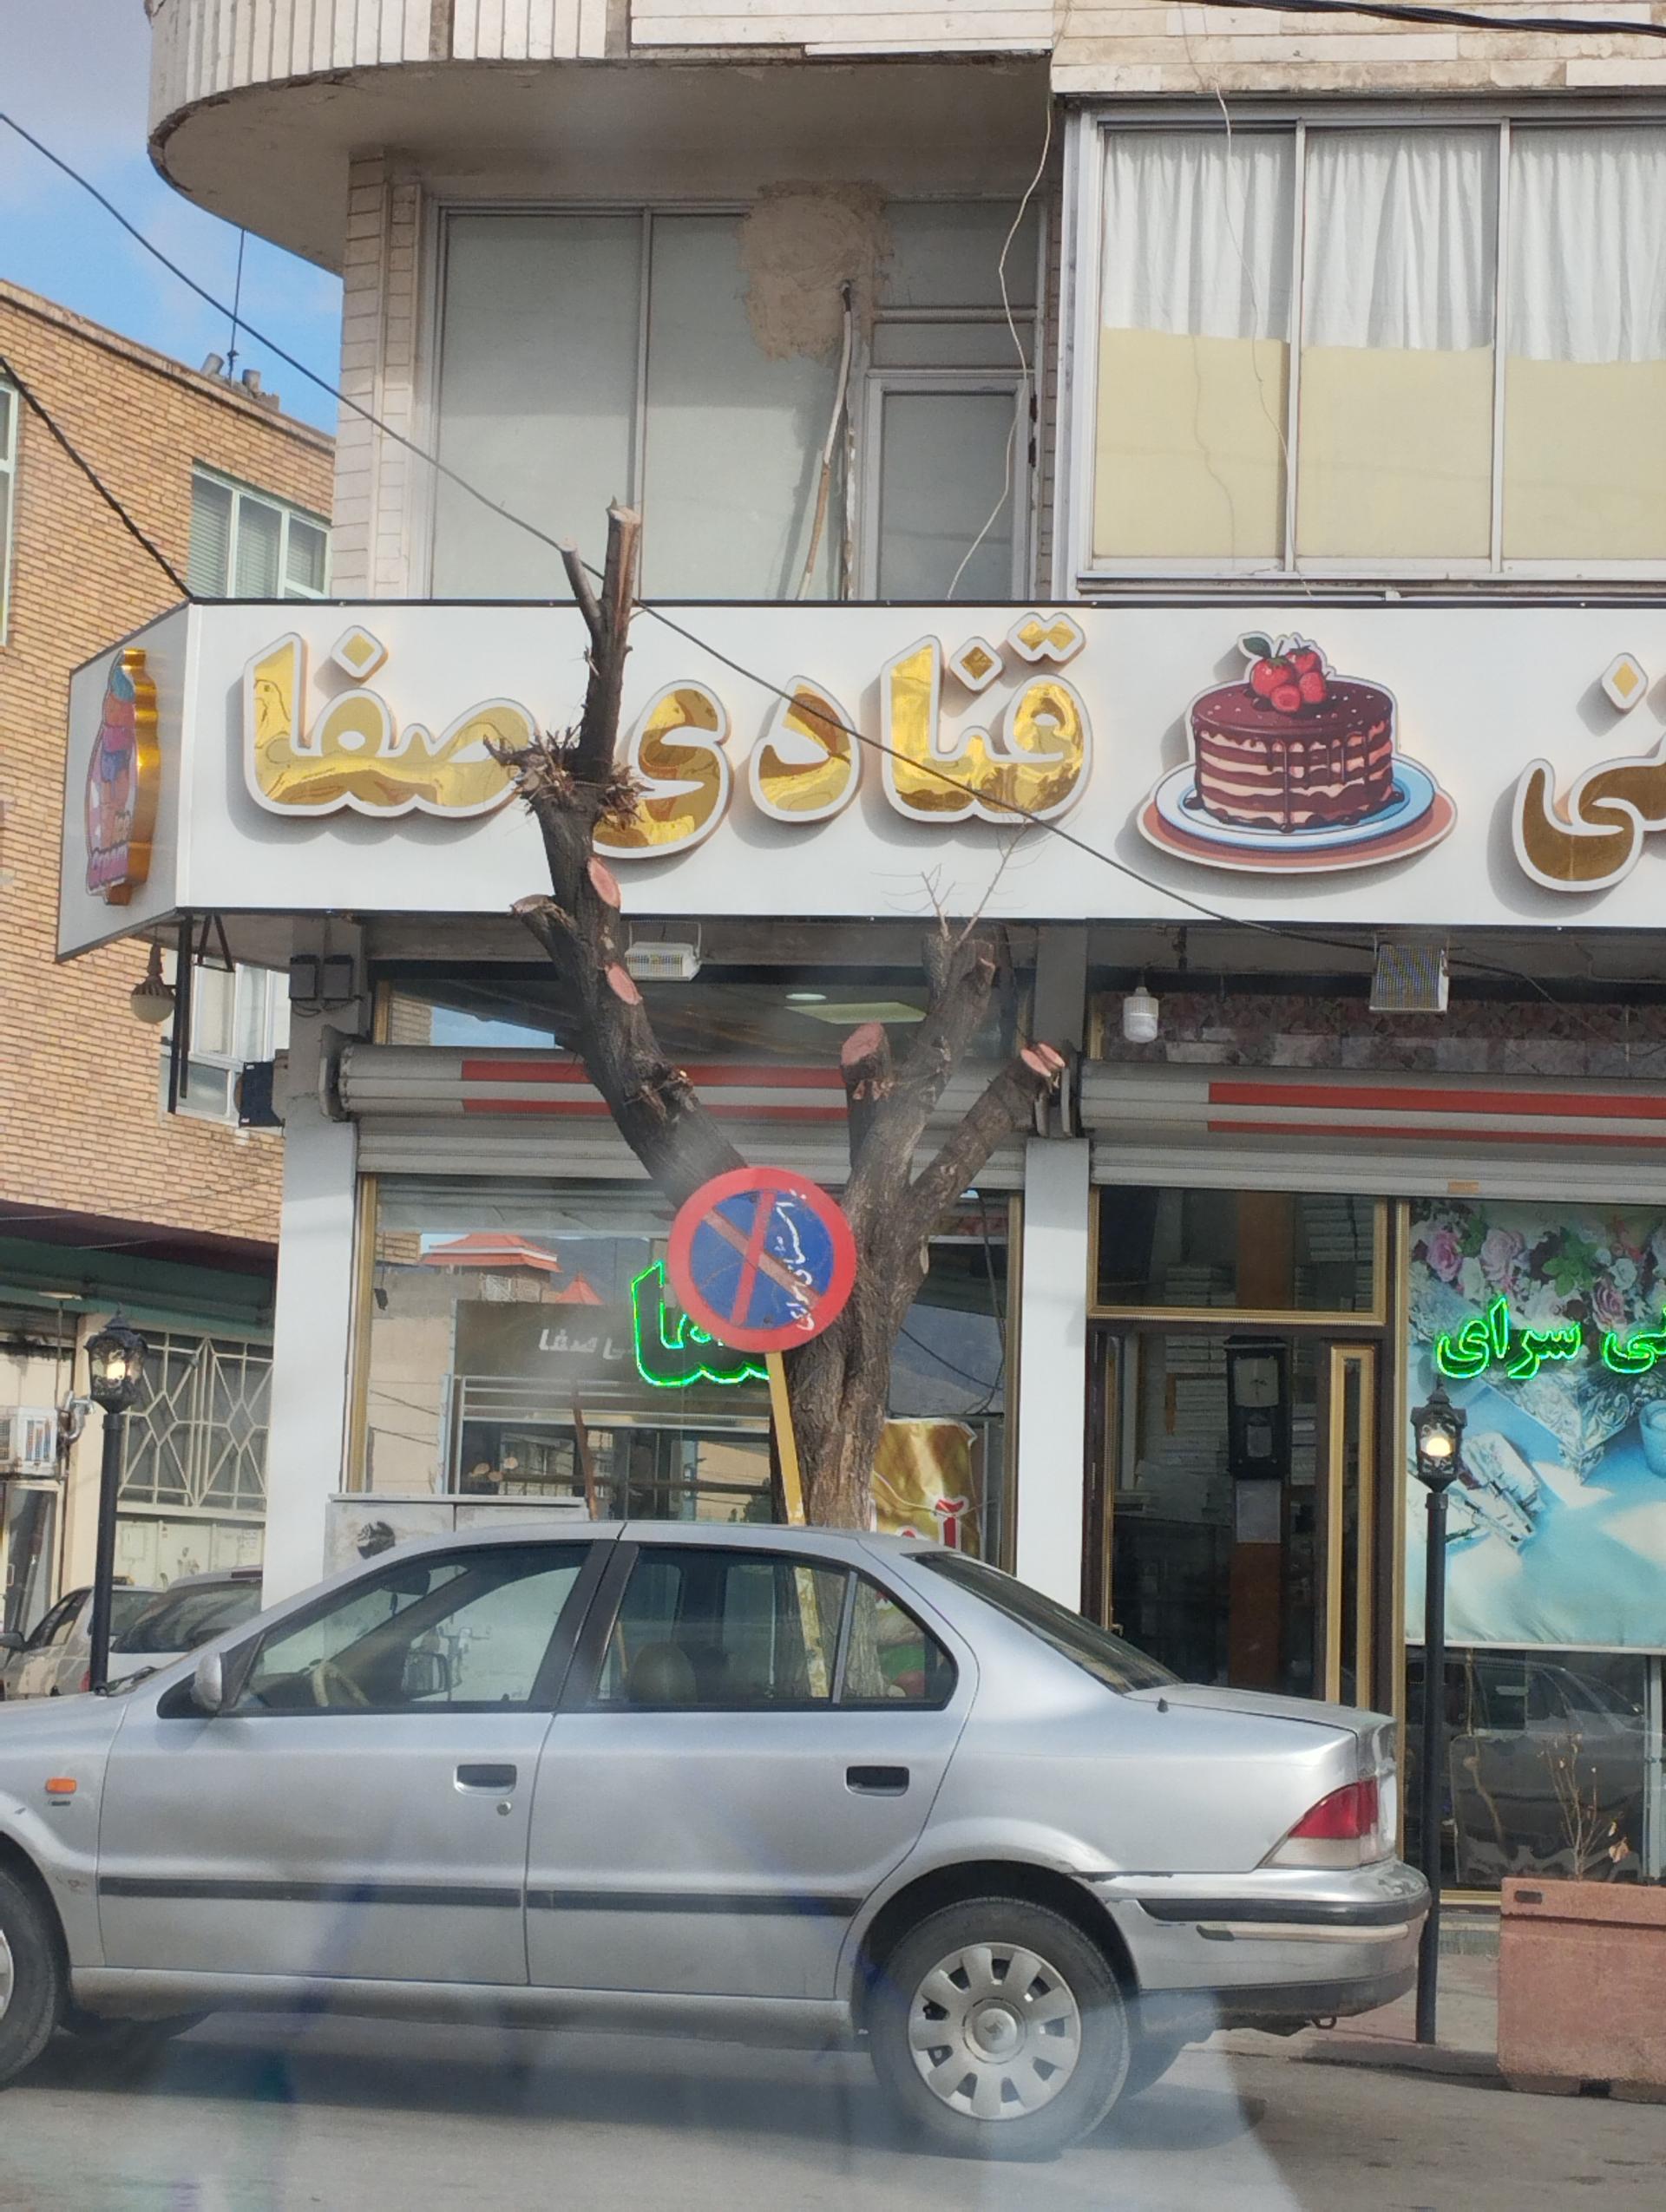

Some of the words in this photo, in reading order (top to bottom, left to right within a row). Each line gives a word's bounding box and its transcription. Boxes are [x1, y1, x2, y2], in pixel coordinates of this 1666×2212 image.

[244, 625, 540, 818] صفا
[594, 612, 1093, 859] قنادی
[1437, 1295, 1582, 1379] سرای
